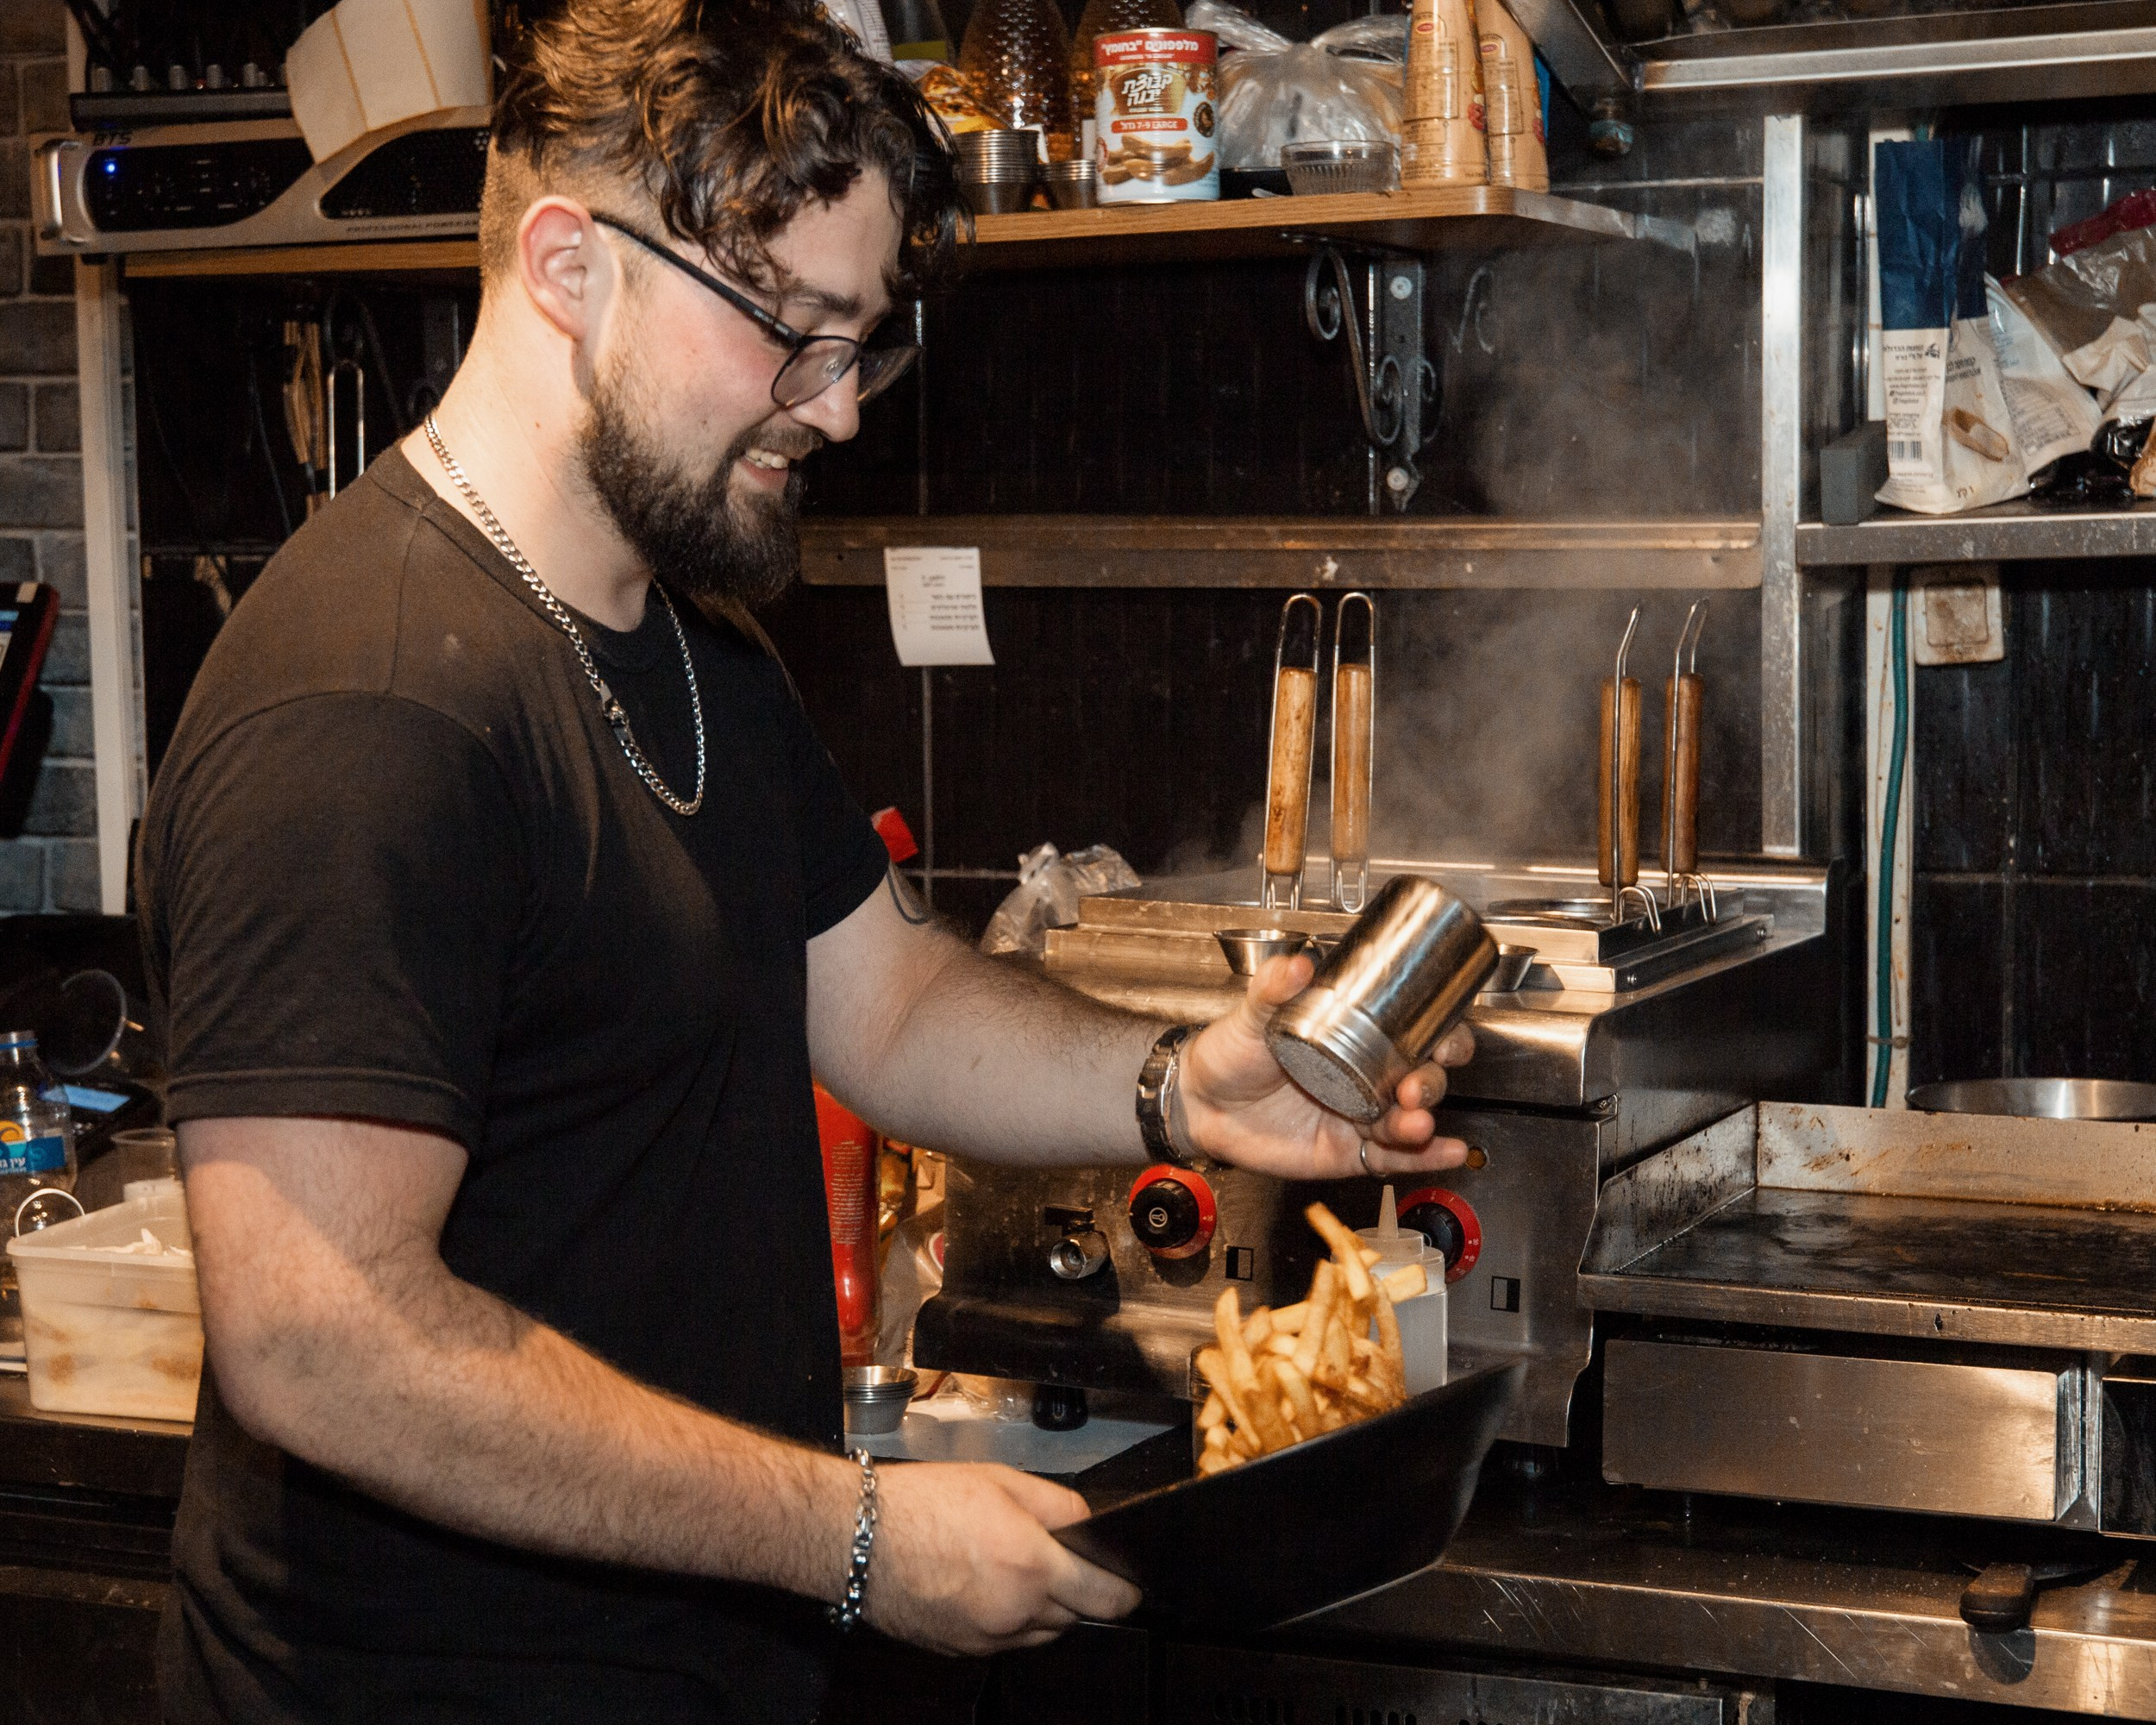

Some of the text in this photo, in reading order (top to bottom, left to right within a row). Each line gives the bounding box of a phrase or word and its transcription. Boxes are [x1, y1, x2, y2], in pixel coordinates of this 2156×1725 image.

[1144, 39, 1199, 52] מלפפונים
[1121, 73, 1173, 94] קבוצת
[1126, 89, 1162, 107] יבנה
[1152, 121, 1178, 129] LARGE
